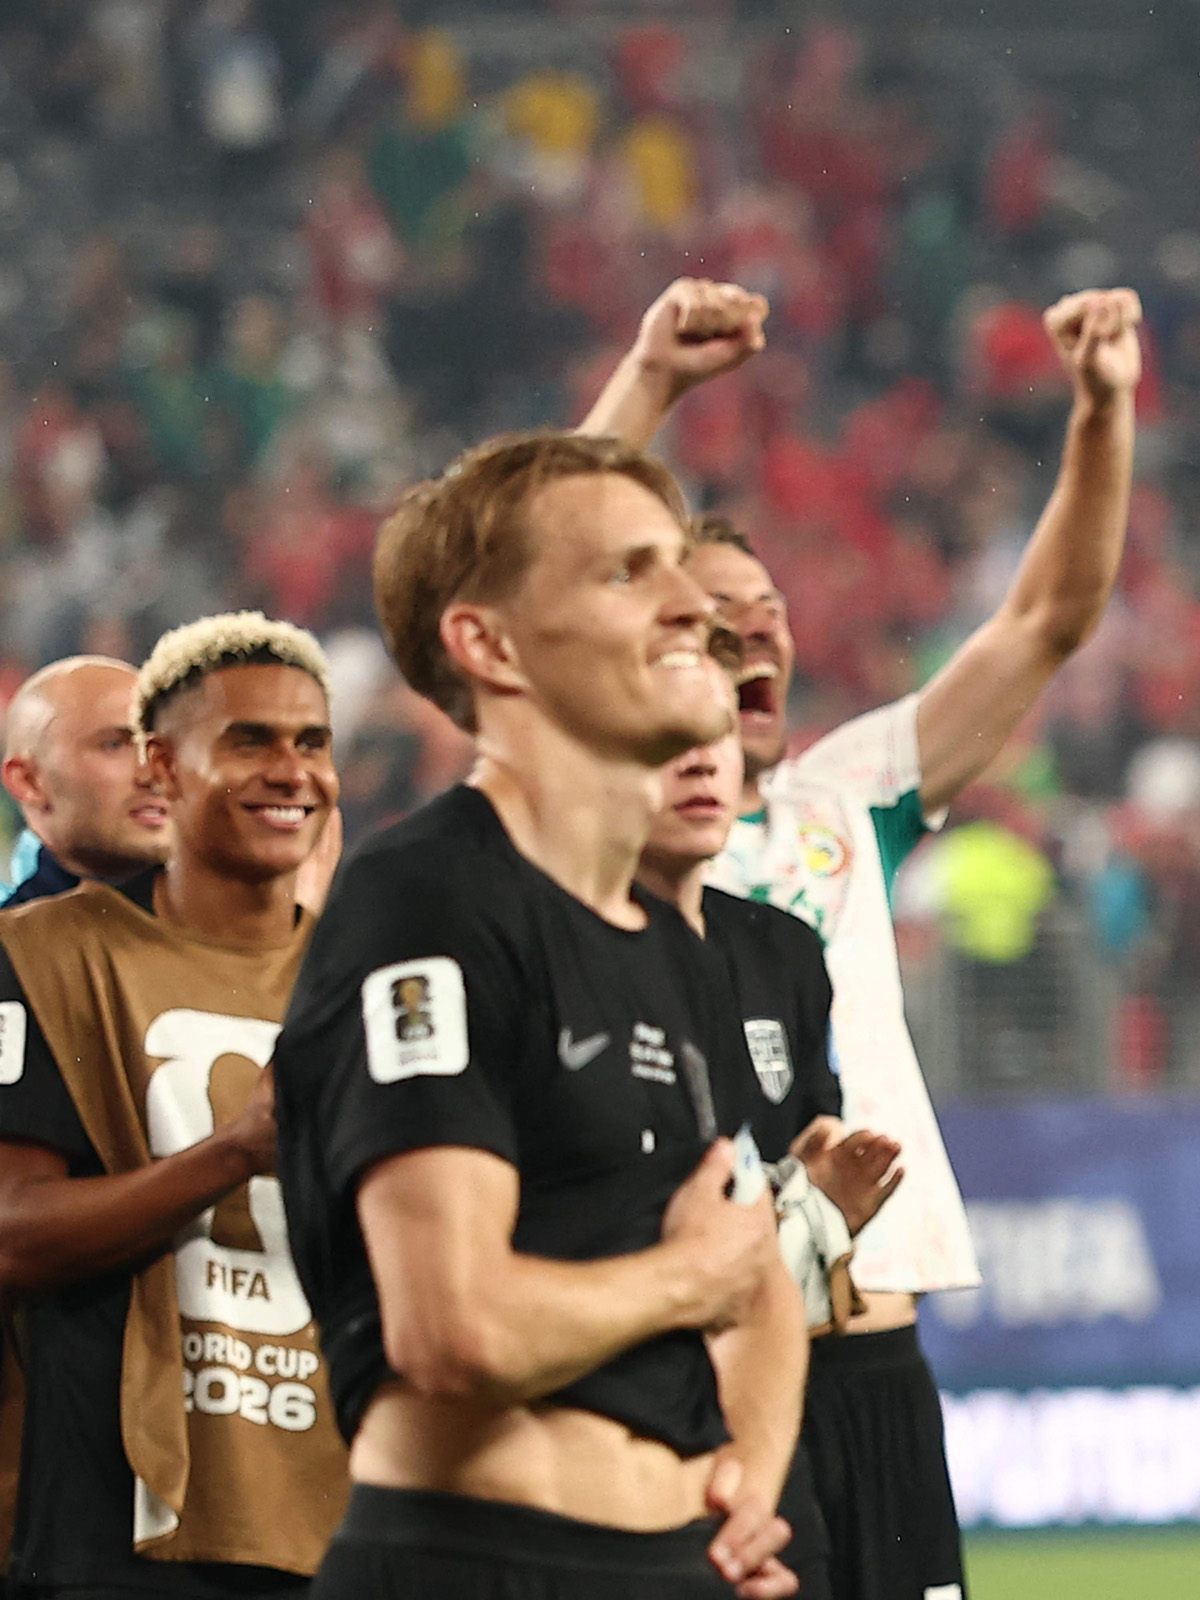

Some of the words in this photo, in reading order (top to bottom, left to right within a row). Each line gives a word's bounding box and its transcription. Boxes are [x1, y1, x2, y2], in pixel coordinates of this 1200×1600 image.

[206, 1260, 271, 1302] FIFA
[183, 1331, 252, 1371] ORLD
[255, 1344, 319, 1380] CUP
